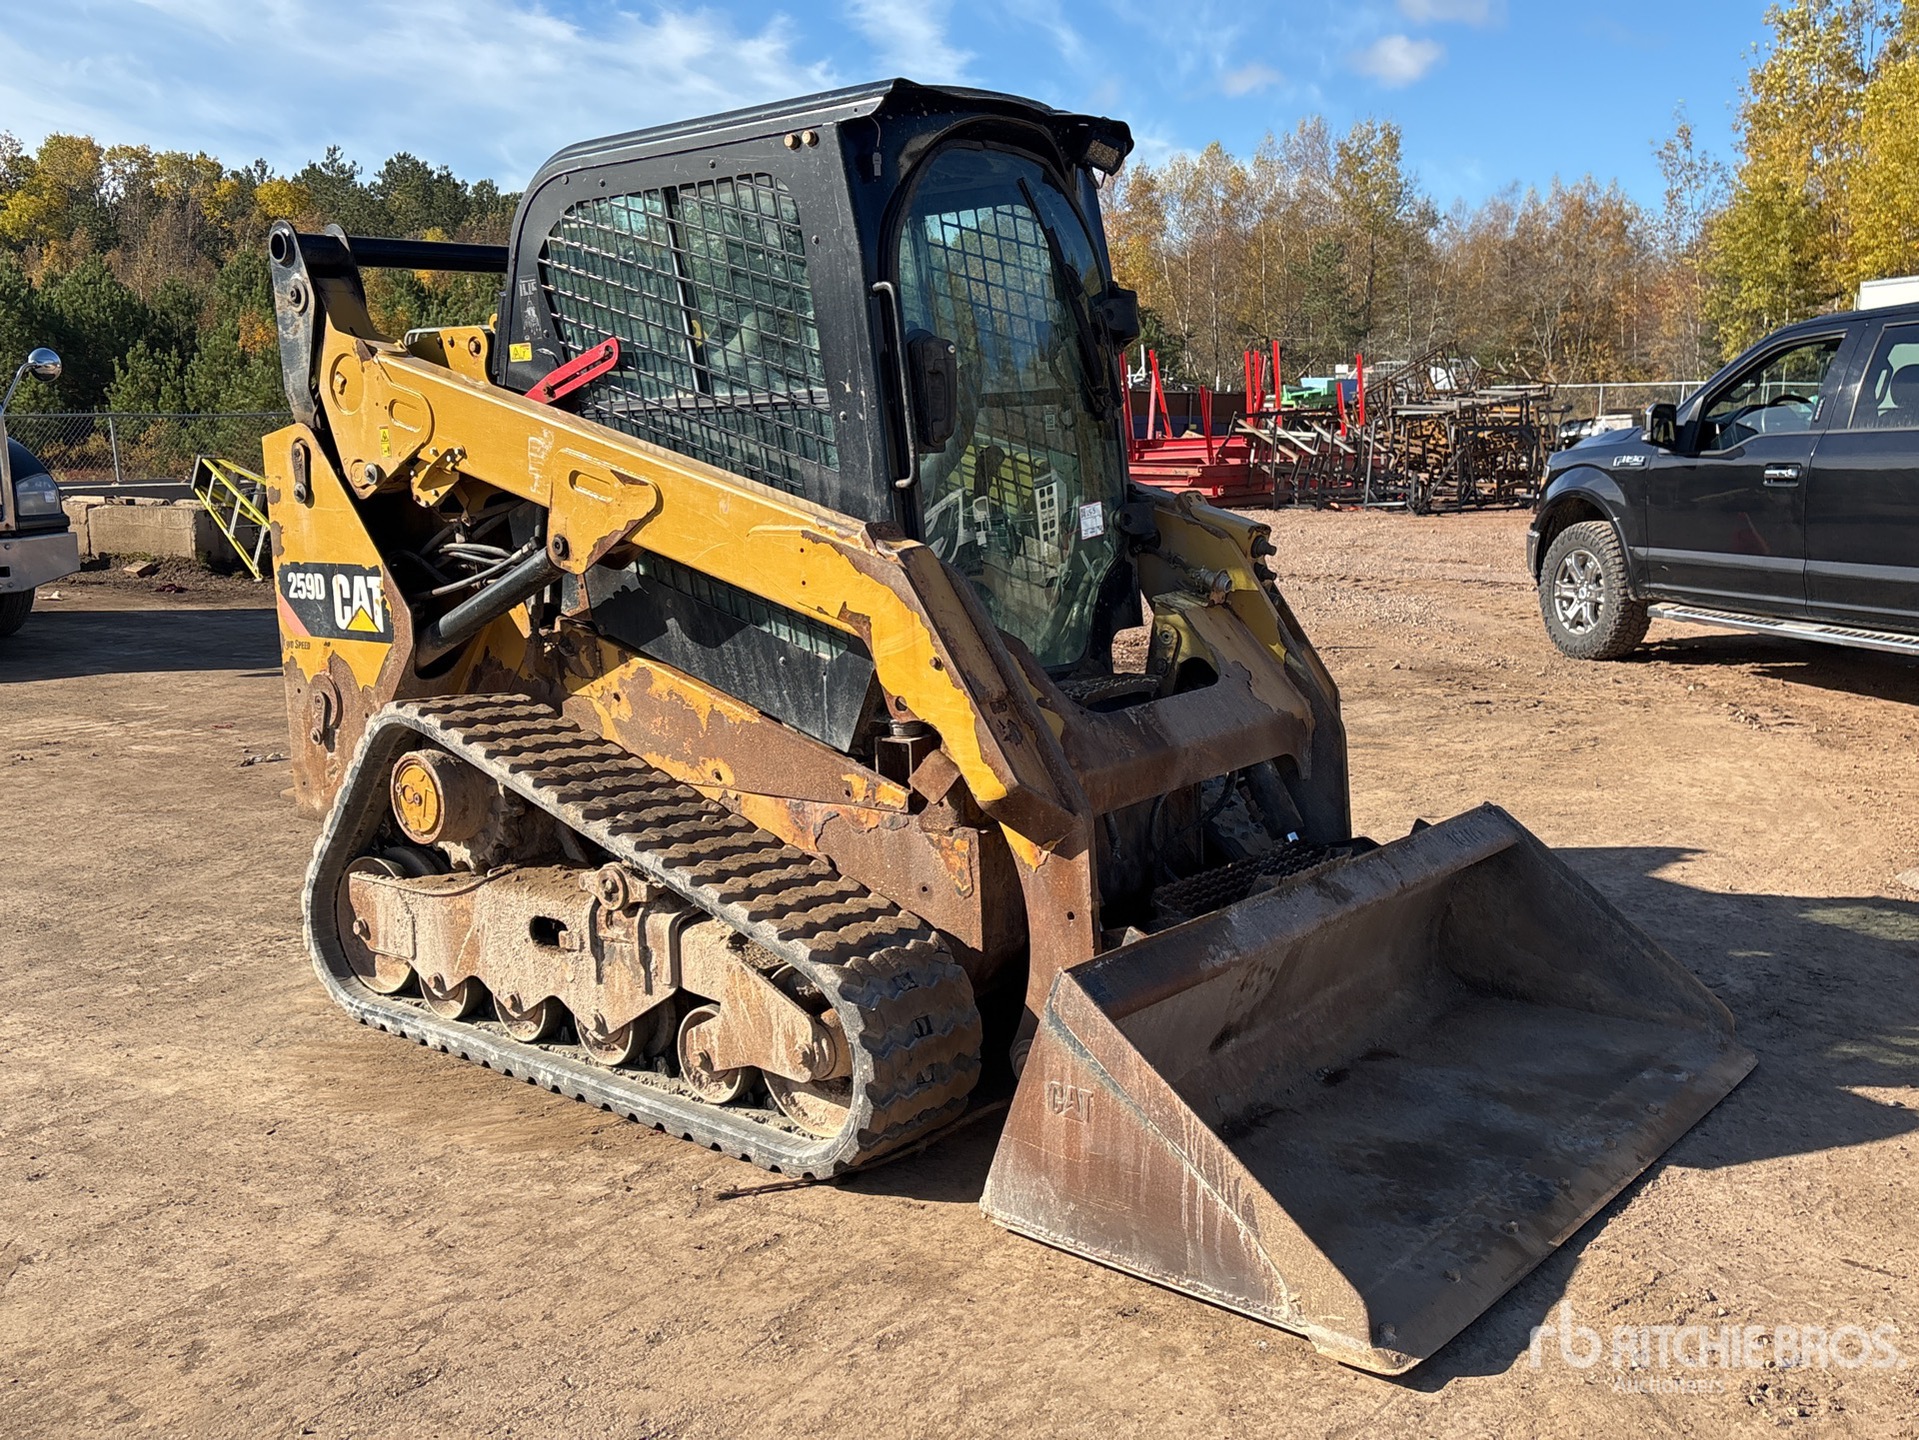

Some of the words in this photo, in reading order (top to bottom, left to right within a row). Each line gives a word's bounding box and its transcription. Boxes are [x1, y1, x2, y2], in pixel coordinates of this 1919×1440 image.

[287, 572, 326, 600] 259D
[332, 574, 384, 633] CAT
[1048, 1080, 1094, 1124] CAT
